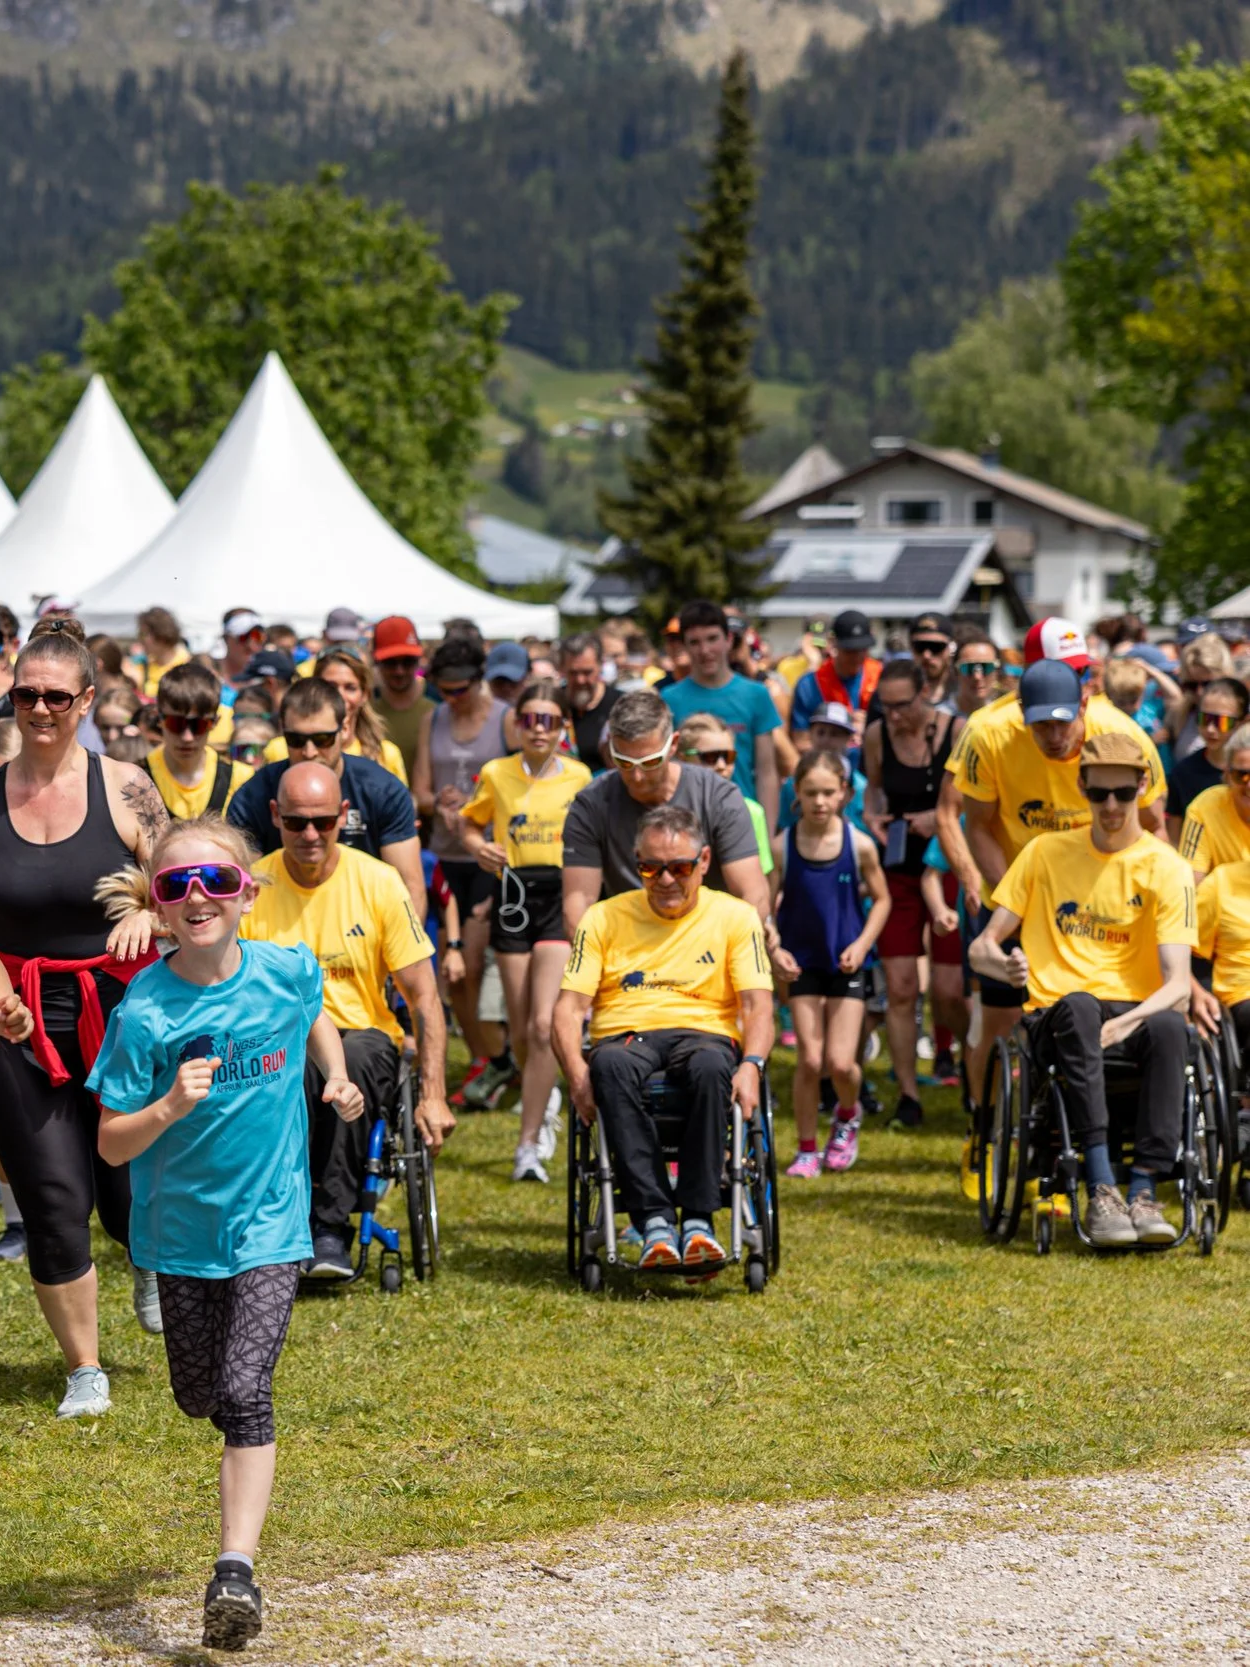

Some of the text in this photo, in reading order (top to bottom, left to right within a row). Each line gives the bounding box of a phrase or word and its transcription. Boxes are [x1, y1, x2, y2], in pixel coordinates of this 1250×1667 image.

[1064, 921, 1130, 944] WORLD RUN
[331, 967, 355, 980] RUN
[215, 1038, 257, 1056] WINGS
[262, 1048, 286, 1075] RUN
[216, 1073, 281, 1094] APPRUN SAALFELDEN
